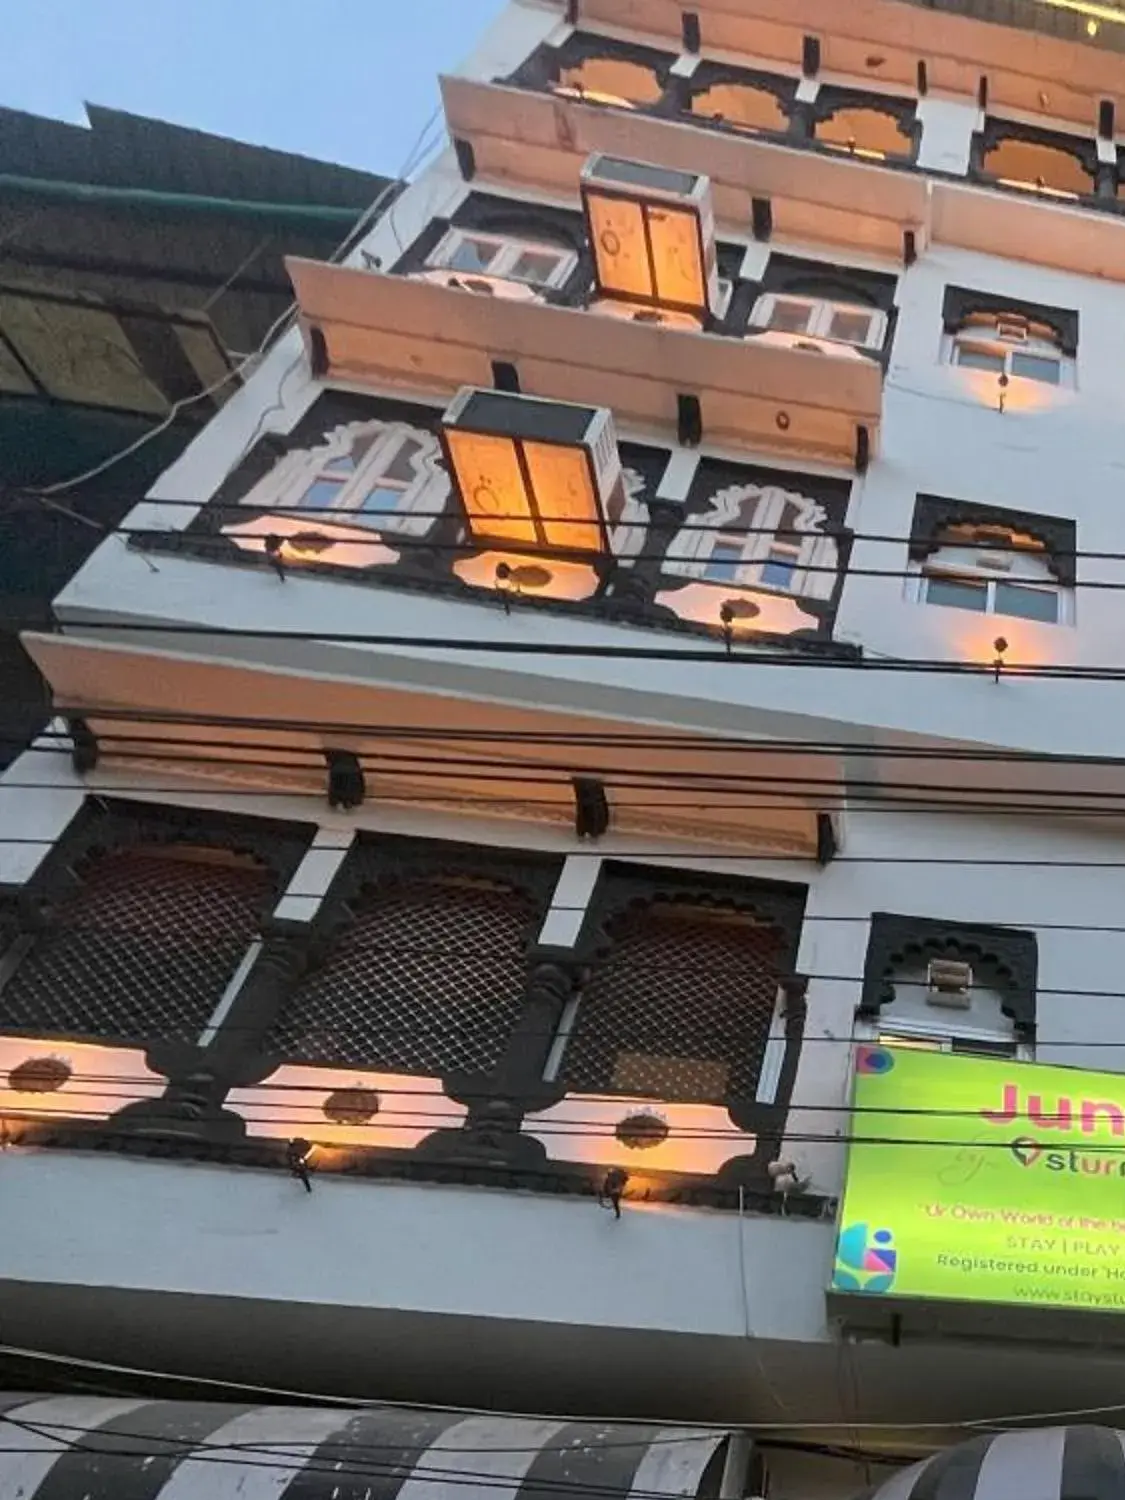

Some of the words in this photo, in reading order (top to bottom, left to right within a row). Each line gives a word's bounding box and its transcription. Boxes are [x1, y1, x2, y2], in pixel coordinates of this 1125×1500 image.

[951, 1204, 995, 1220] Own
[1001, 1209, 1053, 1226] World
[1007, 1235, 1057, 1251] STAY
[1074, 1240, 1120, 1257] PLAY
[937, 1252, 1039, 1273] Registered
[1044, 1261, 1098, 1278] under
